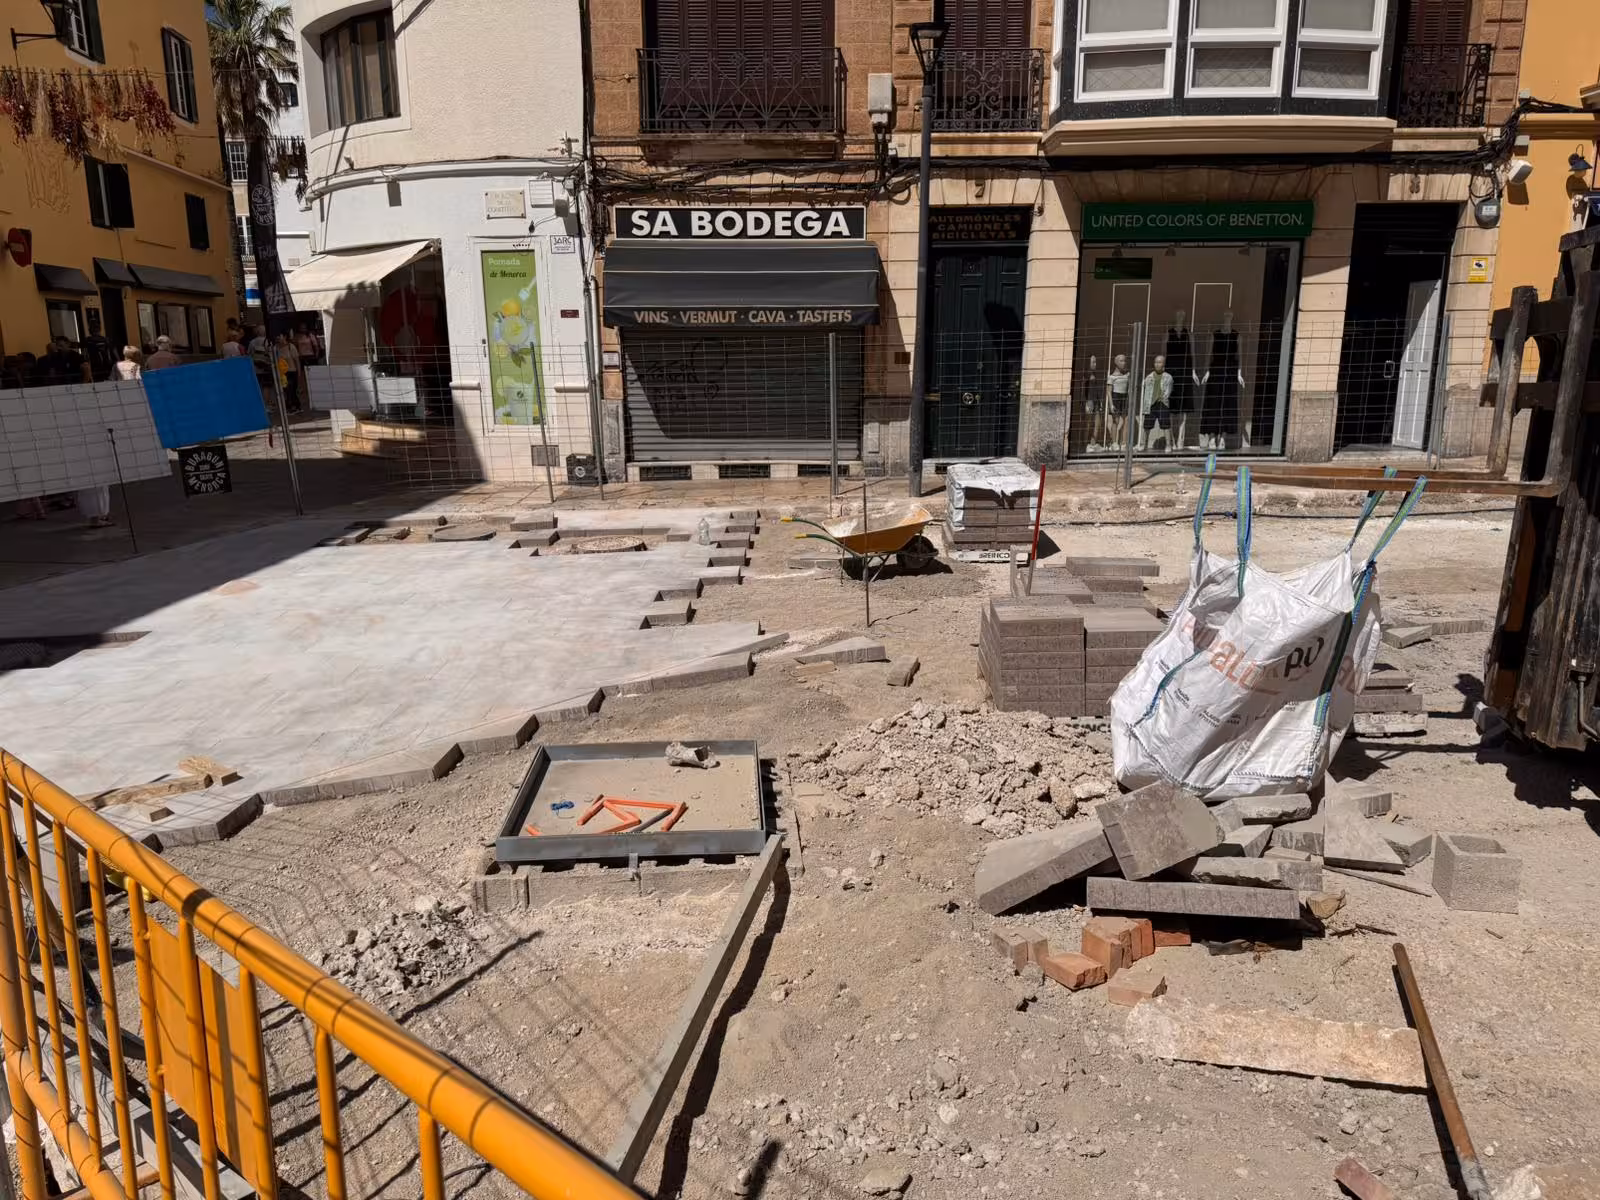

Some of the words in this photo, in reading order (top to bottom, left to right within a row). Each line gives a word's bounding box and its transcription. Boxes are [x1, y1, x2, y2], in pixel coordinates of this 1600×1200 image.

[631, 210, 679, 237] SA
[691, 210, 851, 237] BODEGA
[1091, 215, 1143, 228] UNITED
[1146, 214, 1204, 227] COLORS
[1206, 214, 1226, 226] OF
[937, 223, 1011, 231] CAMIONES
[932, 231, 1017, 240] BICICLETAS
[488, 258, 521, 266] Pomada
[499, 270, 527, 278] Menorca
[633, 310, 669, 324] VINS
[680, 310, 738, 324] VERMUT
[748, 310, 786, 323] CAVA
[797, 309, 852, 323] TASTETS
